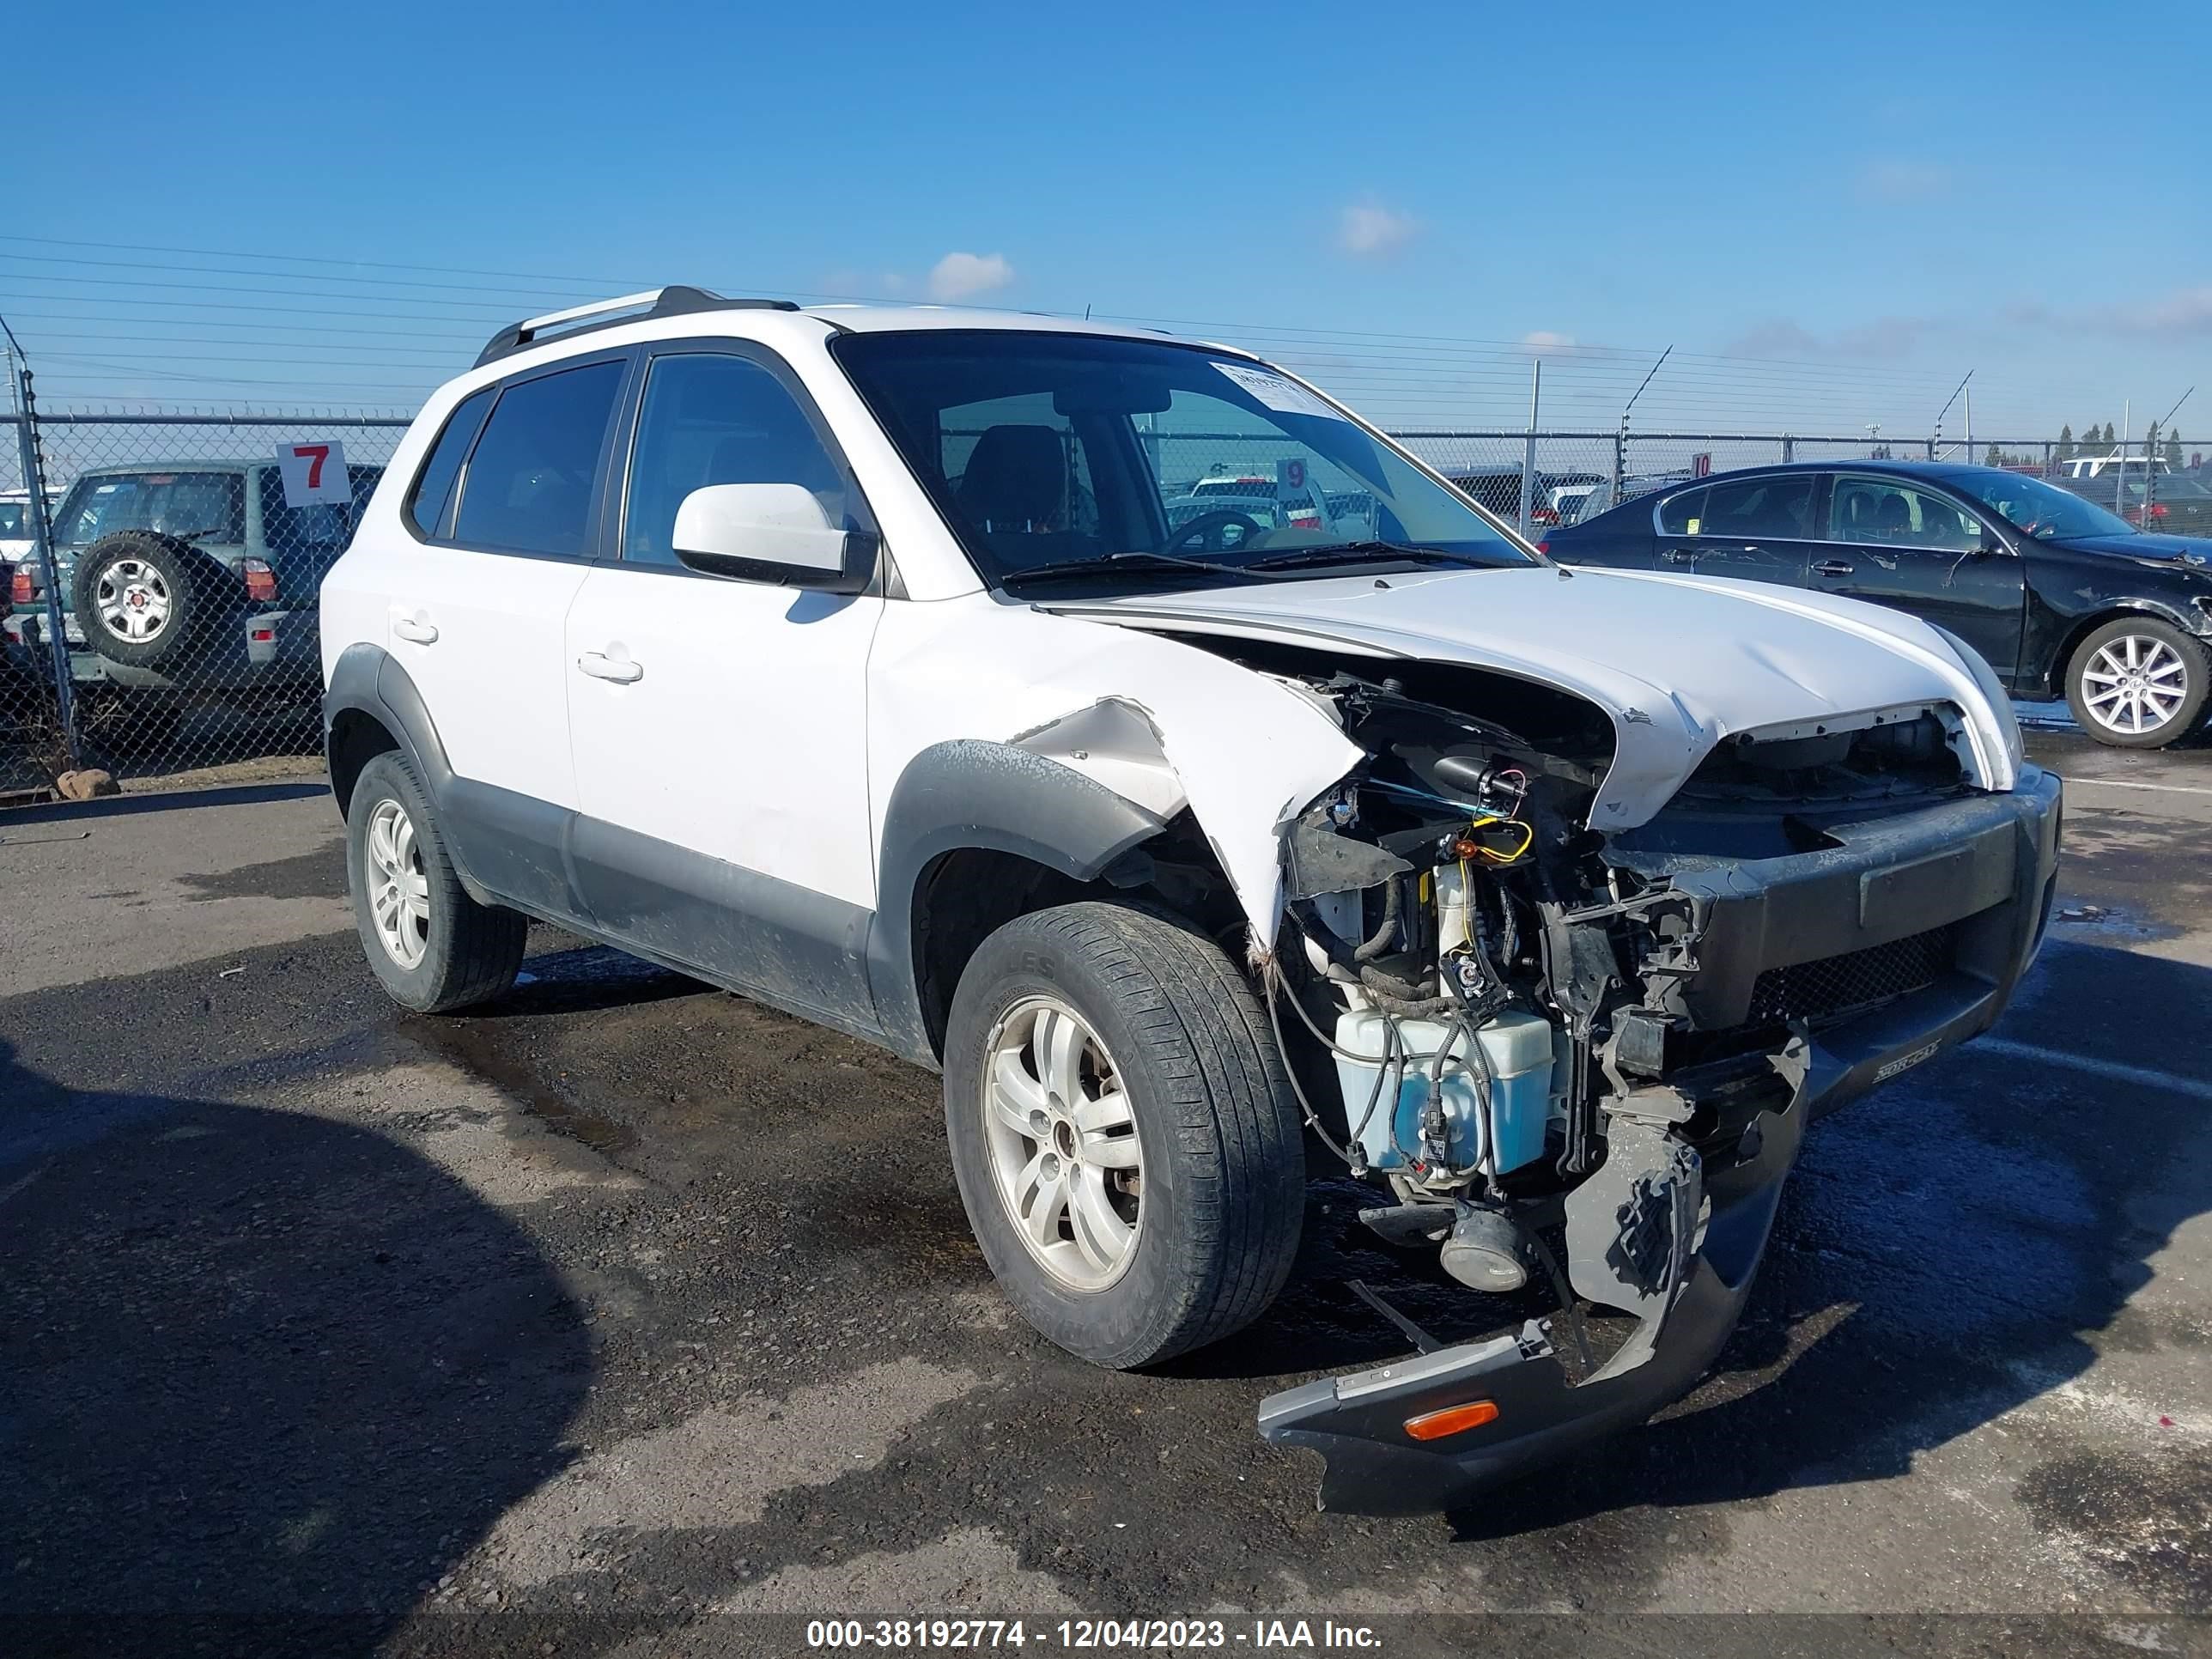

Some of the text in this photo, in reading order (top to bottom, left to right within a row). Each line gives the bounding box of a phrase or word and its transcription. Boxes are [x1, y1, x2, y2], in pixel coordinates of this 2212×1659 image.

[293, 445, 330, 489] 7
[1287, 460, 1305, 489] 9
[1696, 455, 1709, 477] 10
